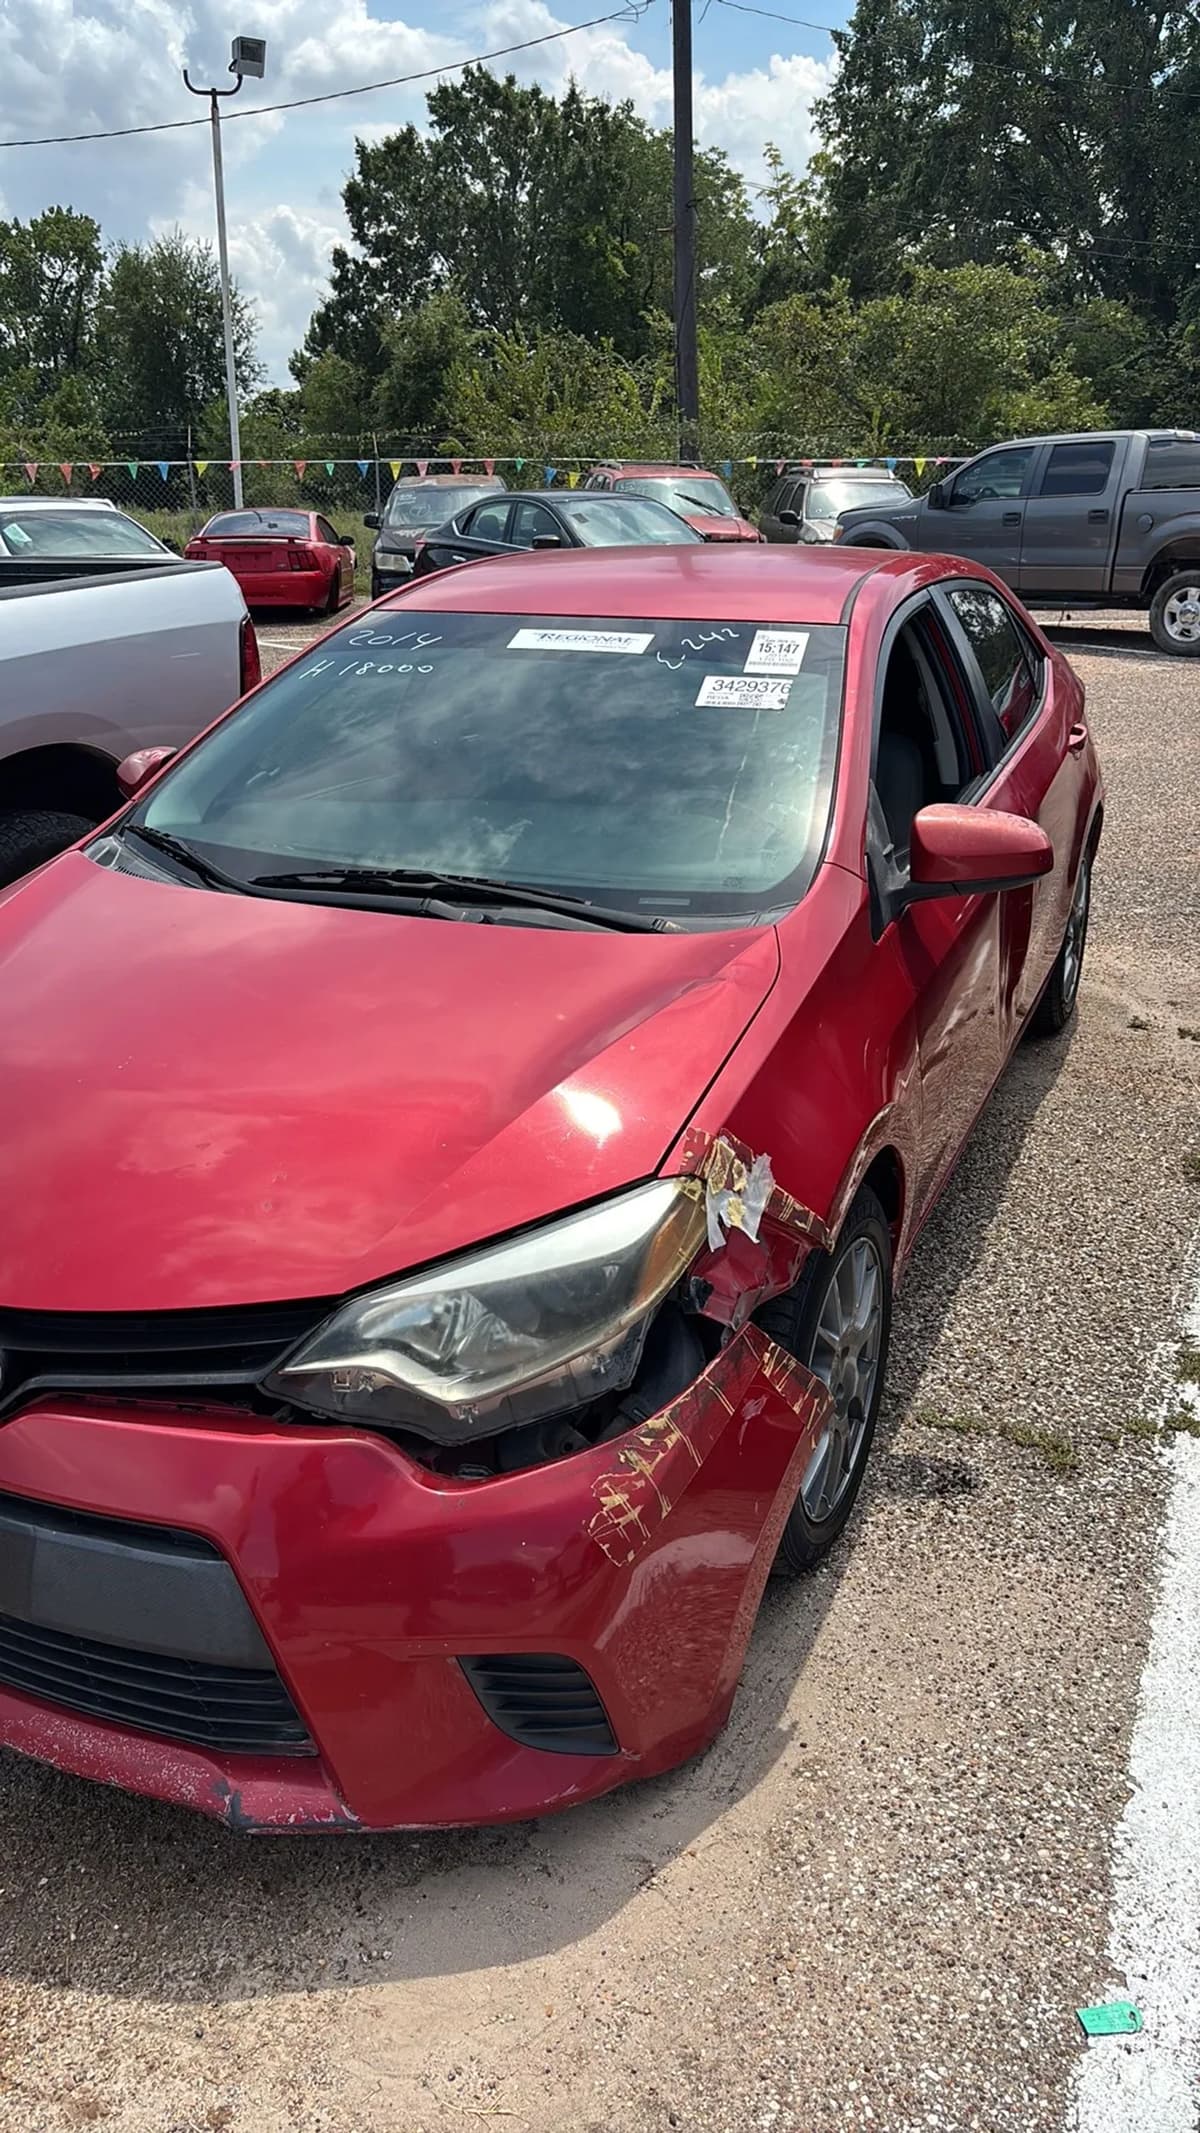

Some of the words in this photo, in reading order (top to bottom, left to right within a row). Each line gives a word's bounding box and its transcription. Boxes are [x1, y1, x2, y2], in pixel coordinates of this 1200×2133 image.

[348, 629, 443, 651] 2014
[758, 642, 800, 655] 15:147
[298, 659, 336, 679] H
[338, 661, 434, 676] 18000
[712, 679, 792, 694] 3429376
